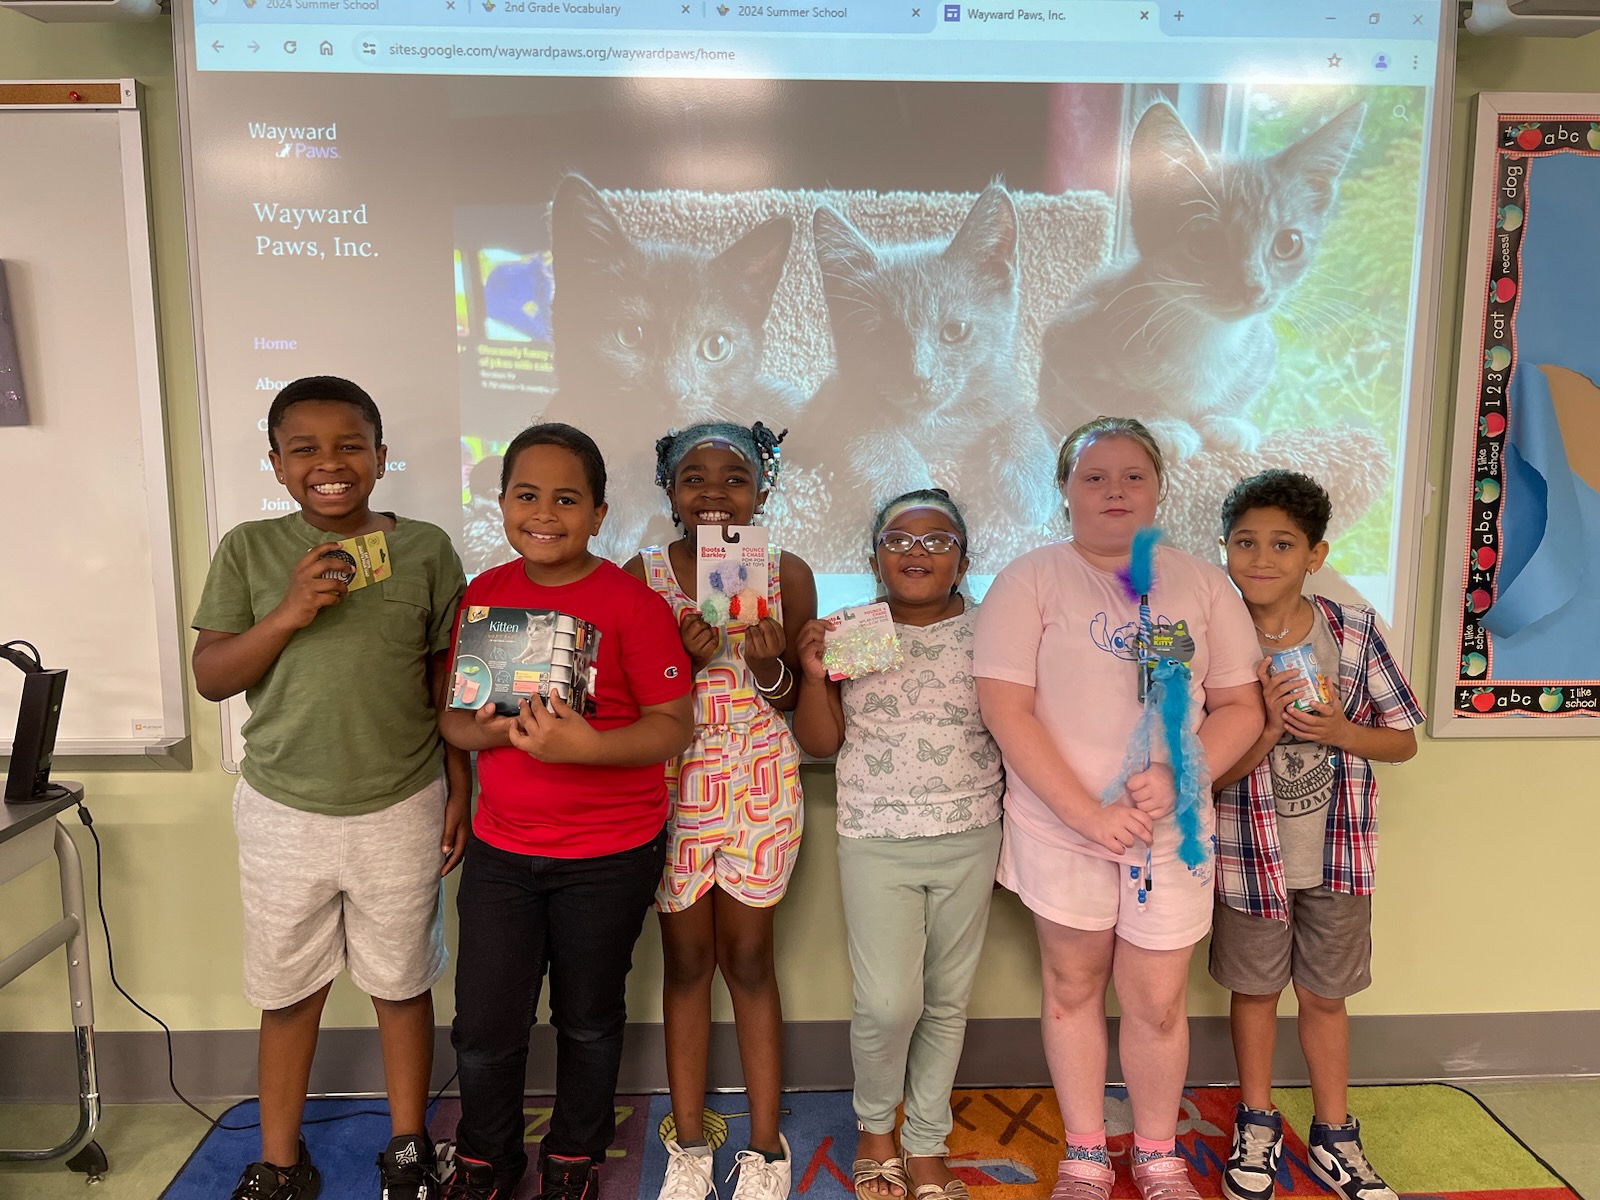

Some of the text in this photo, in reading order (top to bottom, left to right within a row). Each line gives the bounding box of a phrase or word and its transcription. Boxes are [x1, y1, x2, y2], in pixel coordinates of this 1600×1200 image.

[266, 0, 380, 11] 2024 Summer School
[504, 2, 621, 17] 2nd Grade Vocabulary
[738, 6, 848, 19] 2024 Summer School
[967, 9, 1067, 24] Wayward Paws, Inc.
[389, 43, 735, 62] sites.google.com/waywardpaws.org/waywardpaws/home
[248, 122, 337, 144] Wayward
[1502, 165, 1523, 198] dog
[253, 202, 369, 229] Wayward
[256, 236, 379, 260] Paws, Inc.
[1490, 311, 1504, 339] cat
[254, 337, 297, 350] Home
[1477, 448, 1487, 463] like
[1487, 442, 1500, 475] school
[261, 497, 290, 511] Join
[490, 621, 519, 633] Kitten
[1464, 624, 1474, 640] like
[1570, 687, 1592, 699] I like
[1565, 698, 1597, 708] school
